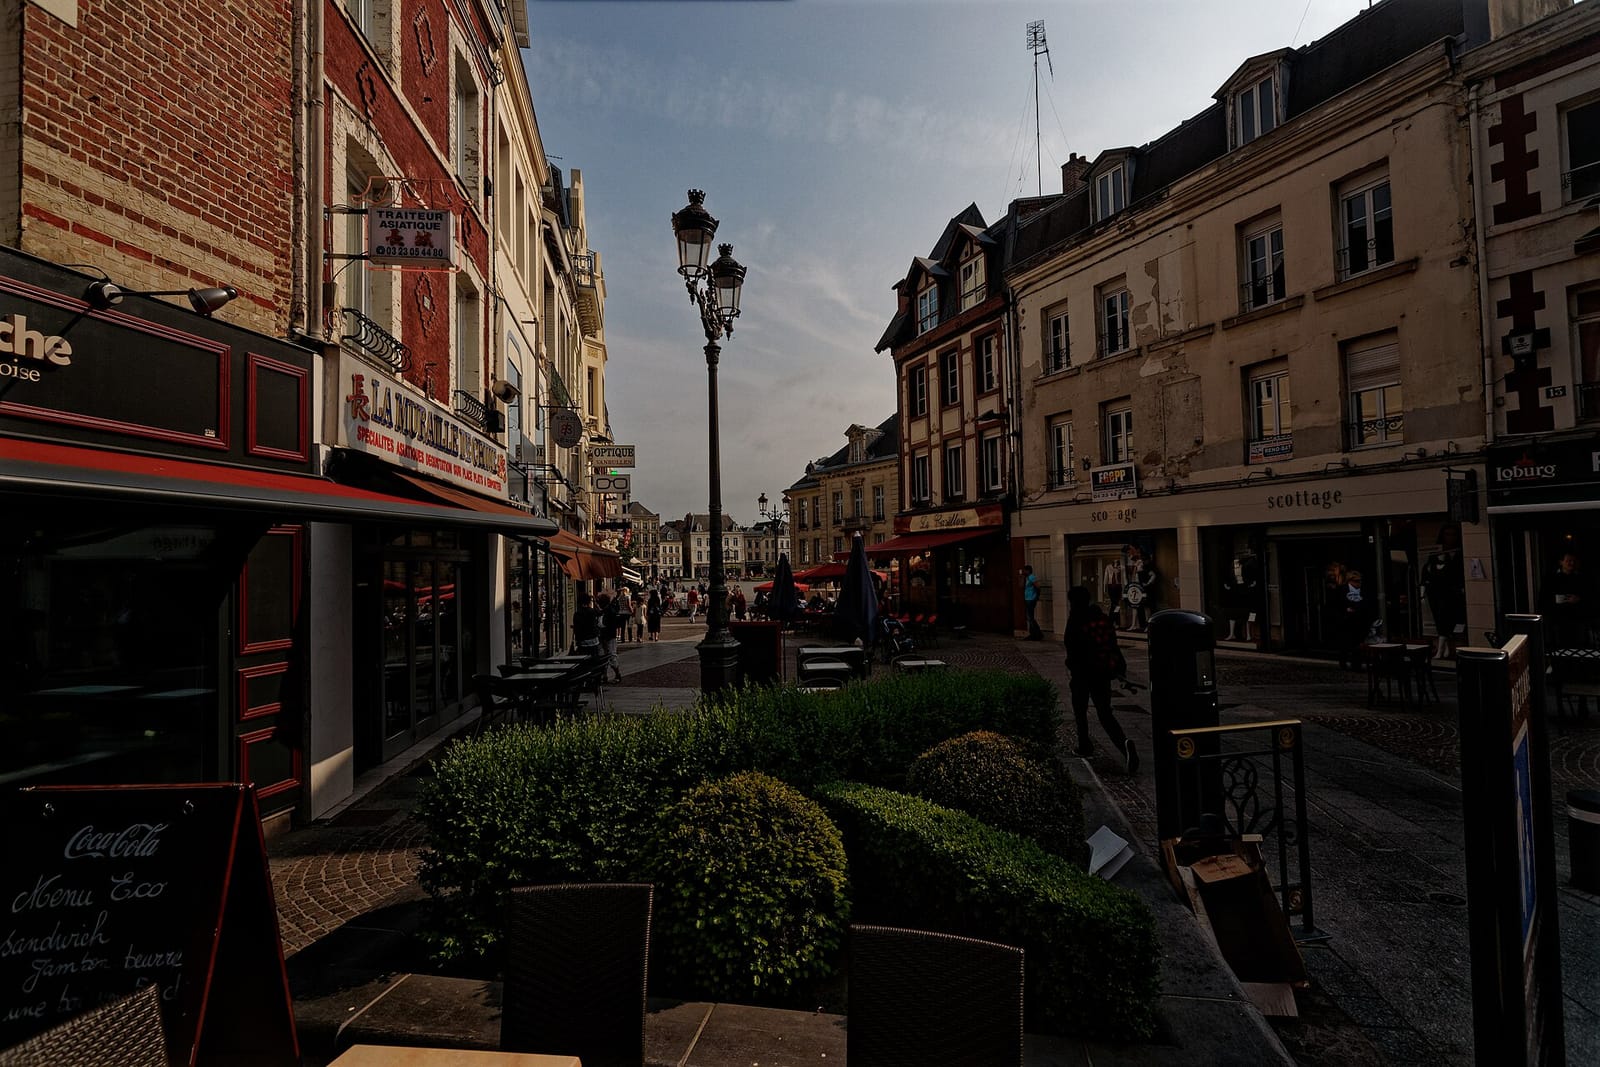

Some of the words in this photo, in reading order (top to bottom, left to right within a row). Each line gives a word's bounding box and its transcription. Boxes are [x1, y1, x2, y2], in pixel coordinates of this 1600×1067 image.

[376, 210, 443, 220] TRAITEUR
[379, 220, 441, 230] ASIATIQUE
[386, 246, 397, 255] 03
[398, 247, 408, 256] 23
[409, 247, 420, 256] 05
[421, 248, 431, 257] 44
[371, 379, 394, 429] LA
[394, 392, 459, 458] MURAILLE
[357, 425, 395, 453] SPECIALITES
[396, 440, 425, 464] ASIATIQUES
[593, 447, 634, 457] OPTIQUE
[1267, 489, 1342, 509] scottage
[1091, 508, 1137, 523] scoage
[11, 873, 95, 913] Menu
[110, 871, 168, 901] Eco
